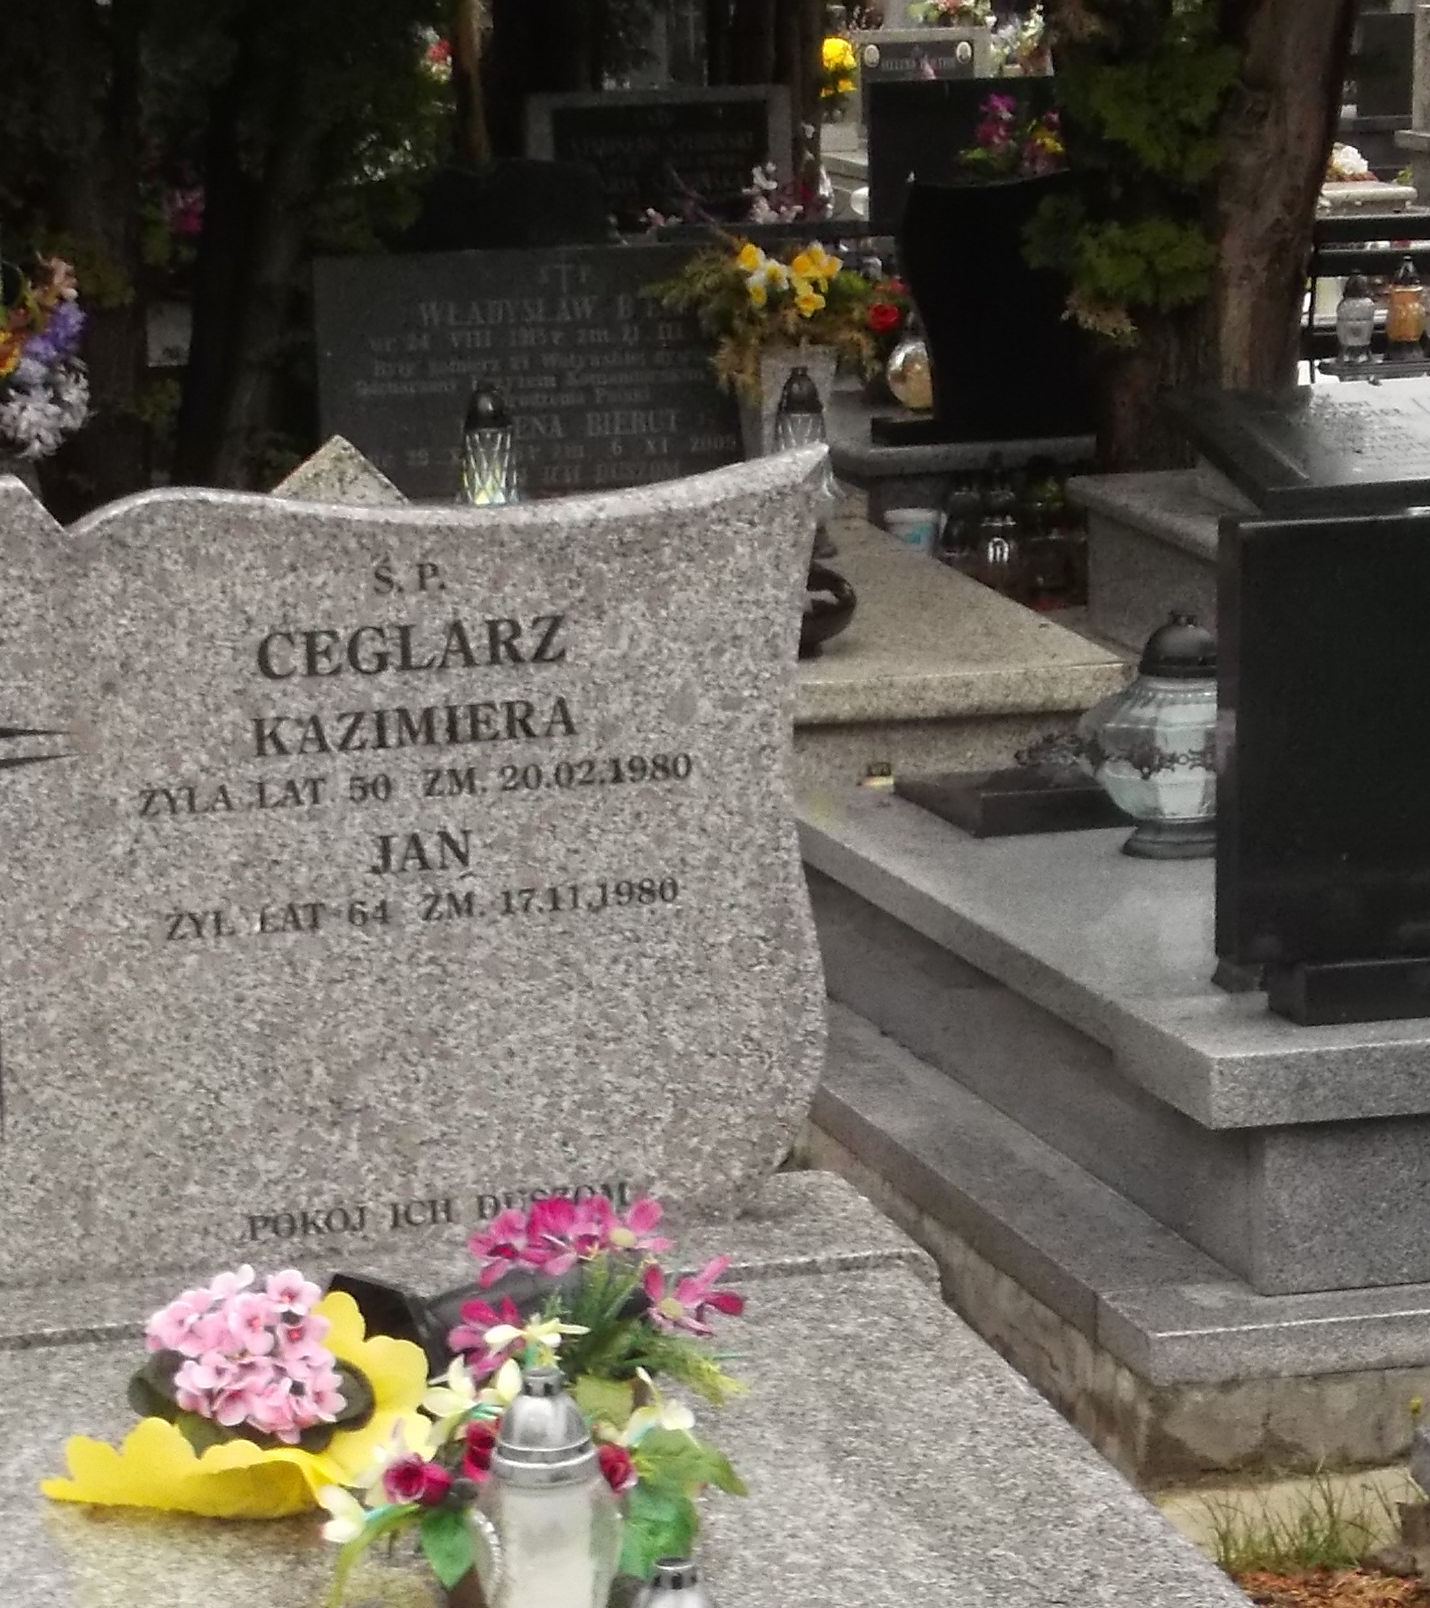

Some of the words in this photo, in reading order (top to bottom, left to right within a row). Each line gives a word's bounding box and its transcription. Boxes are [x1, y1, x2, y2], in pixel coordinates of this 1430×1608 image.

[585, 408, 681, 438] BIERUT
[256, 614, 568, 680] CEGLARZ
[251, 695, 579, 758] KAZIMIERA
[250, 777, 326, 809] LAT
[348, 773, 393, 802] 50
[499, 751, 693, 792] 20.02.1980
[365, 827, 472, 875] JAN
[258, 901, 325, 935] LAT
[347, 898, 390, 927] 64
[387, 1197, 456, 1230] ICH
